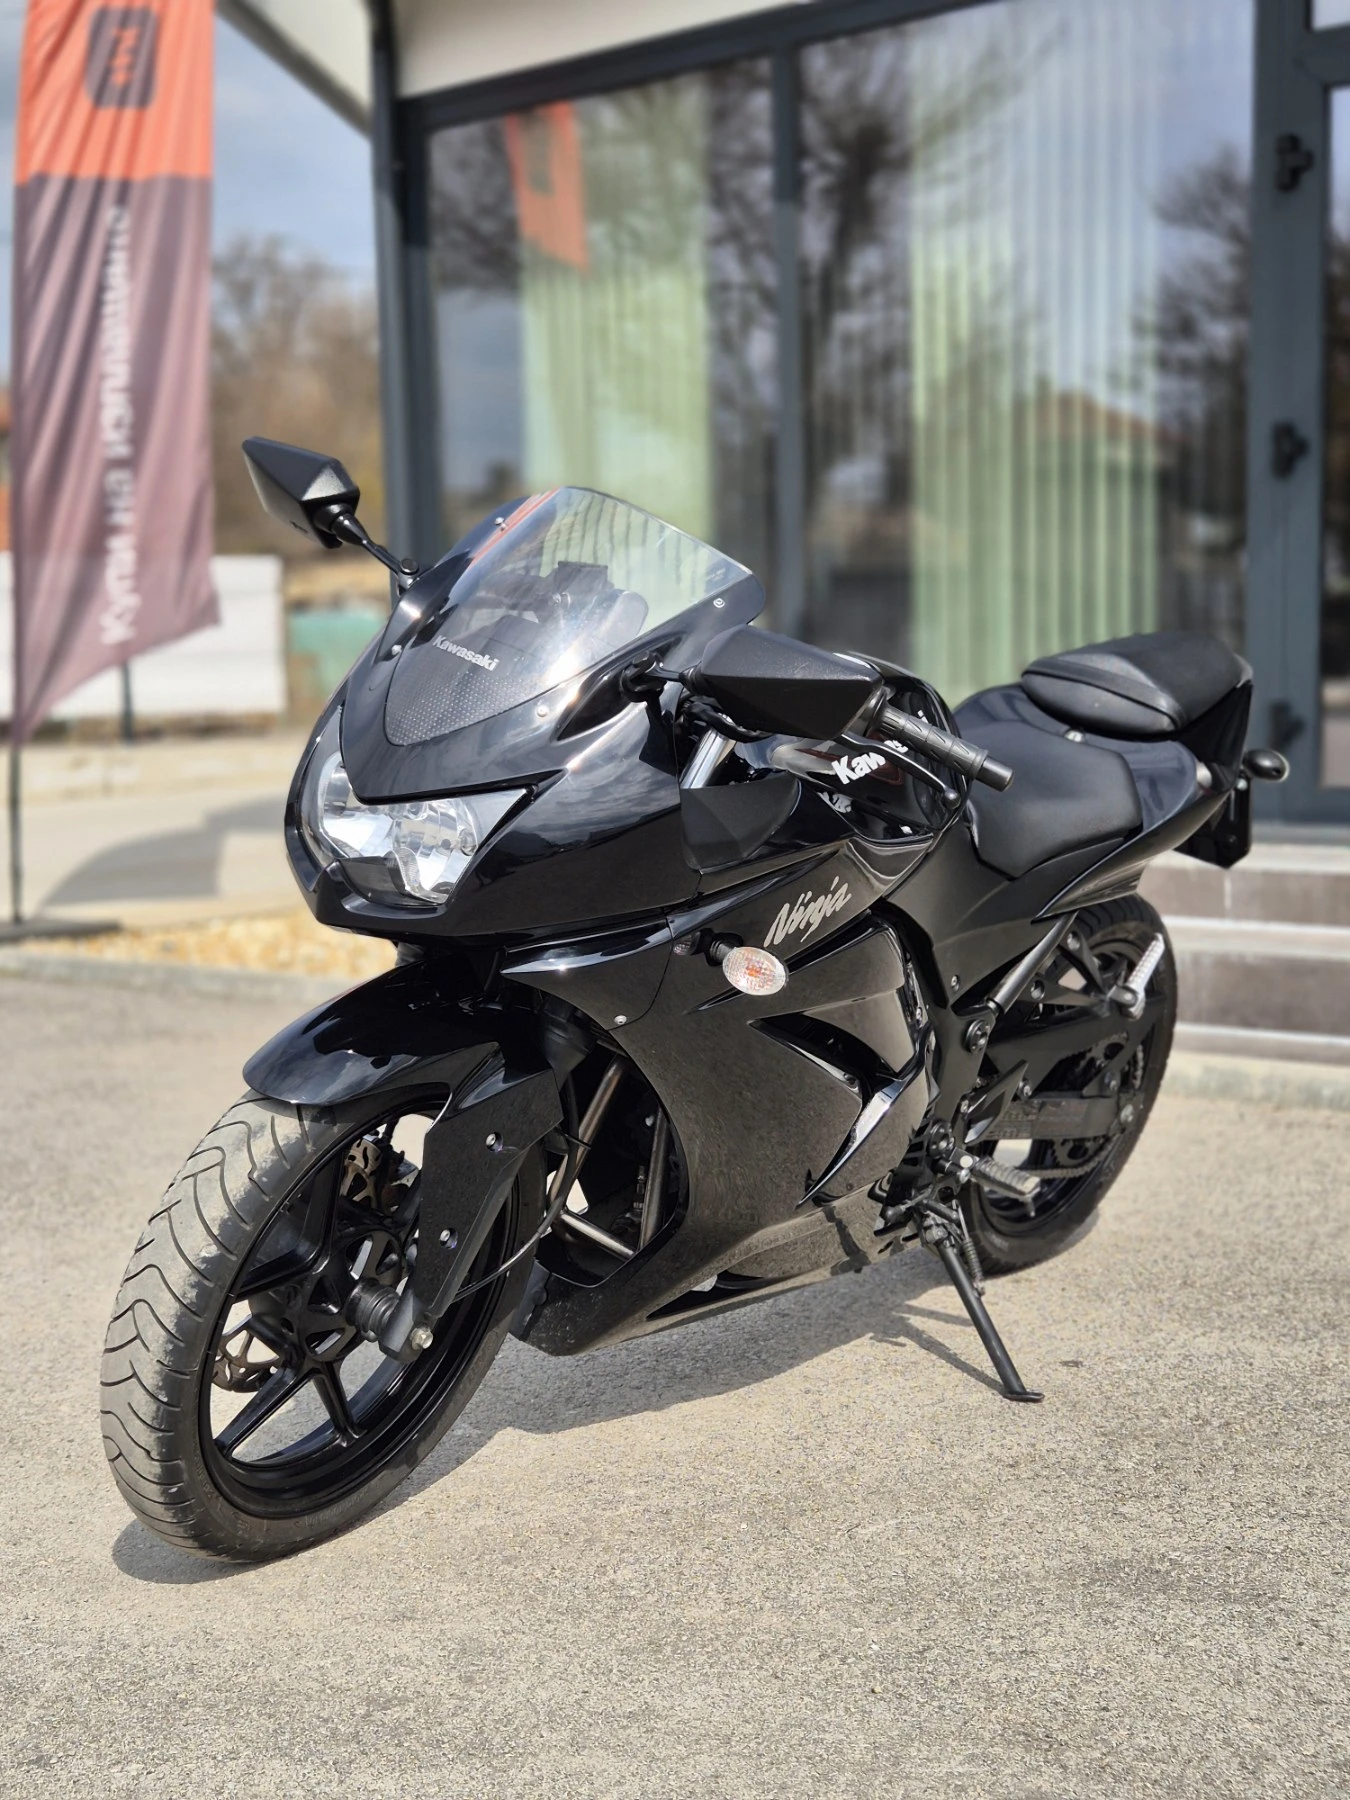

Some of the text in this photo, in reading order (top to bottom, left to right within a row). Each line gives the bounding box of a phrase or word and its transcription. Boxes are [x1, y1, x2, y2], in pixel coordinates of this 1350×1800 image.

[105, 469, 135, 527] на
[100, 534, 141, 644] Купи
[433, 635, 500, 671] Kawasaki
[763, 875, 852, 947] Ninja
